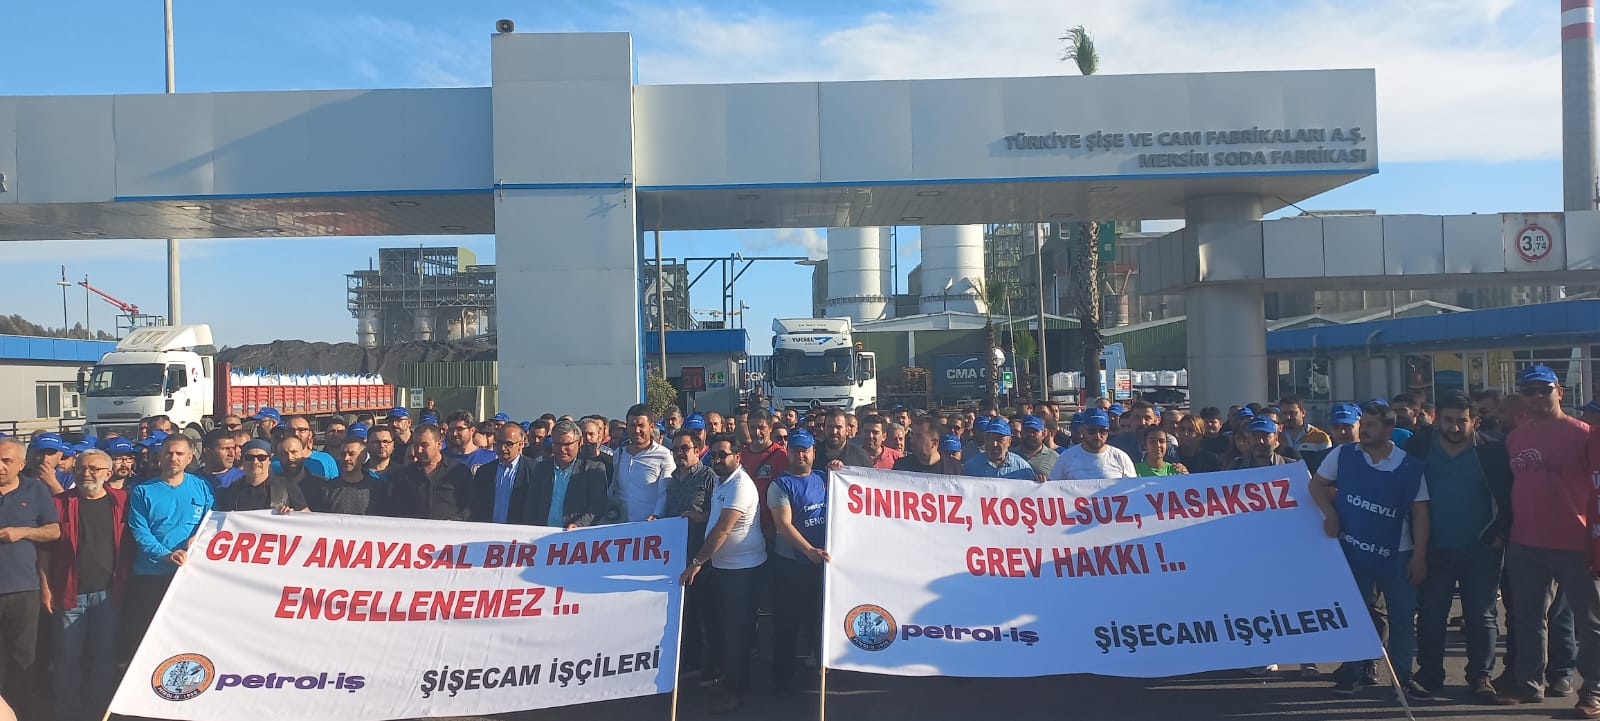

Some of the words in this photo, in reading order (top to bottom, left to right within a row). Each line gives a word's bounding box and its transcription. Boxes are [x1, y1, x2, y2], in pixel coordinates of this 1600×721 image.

[1005, 131, 1081, 150] TÜRKİYE
[1086, 130, 1125, 152] ŞİŞE
[1129, 132, 1153, 147] VE
[1158, 131, 1201, 146] CAM
[1206, 126, 1326, 145] FABRİKALARI
[1331, 127, 1367, 146] A.Ş.
[1138, 149, 1209, 168] MERSİN
[1215, 150, 1267, 167] SODA
[1271, 145, 1367, 164] FABRİKASI
[946, 368, 978, 379] CMA
[847, 484, 973, 532] SINIRSIZ,
[980, 496, 1143, 535] KOŞULSUZ,
[1146, 479, 1298, 521] YASAKSIZ
[1346, 494, 1398, 519] GÖREVLİ
[205, 530, 303, 566] GREV
[303, 537, 474, 570] ANAYASAL
[483, 539, 538, 569] BİR
[546, 535, 671, 566] HAKTIR,
[965, 546, 1043, 578] GREV
[1051, 543, 1150, 577] HAKKI
[274, 585, 546, 622] ENGELLENEMEZ
[901, 624, 1040, 647] petrol-iş
[1093, 620, 1219, 655] ŞİŞECAM
[1223, 600, 1350, 647] İŞÇİLERİ
[215, 672, 365, 692] petrol-iş
[420, 665, 542, 699] ŞİŞECAM
[549, 644, 661, 688] İŞÇİLERİ
